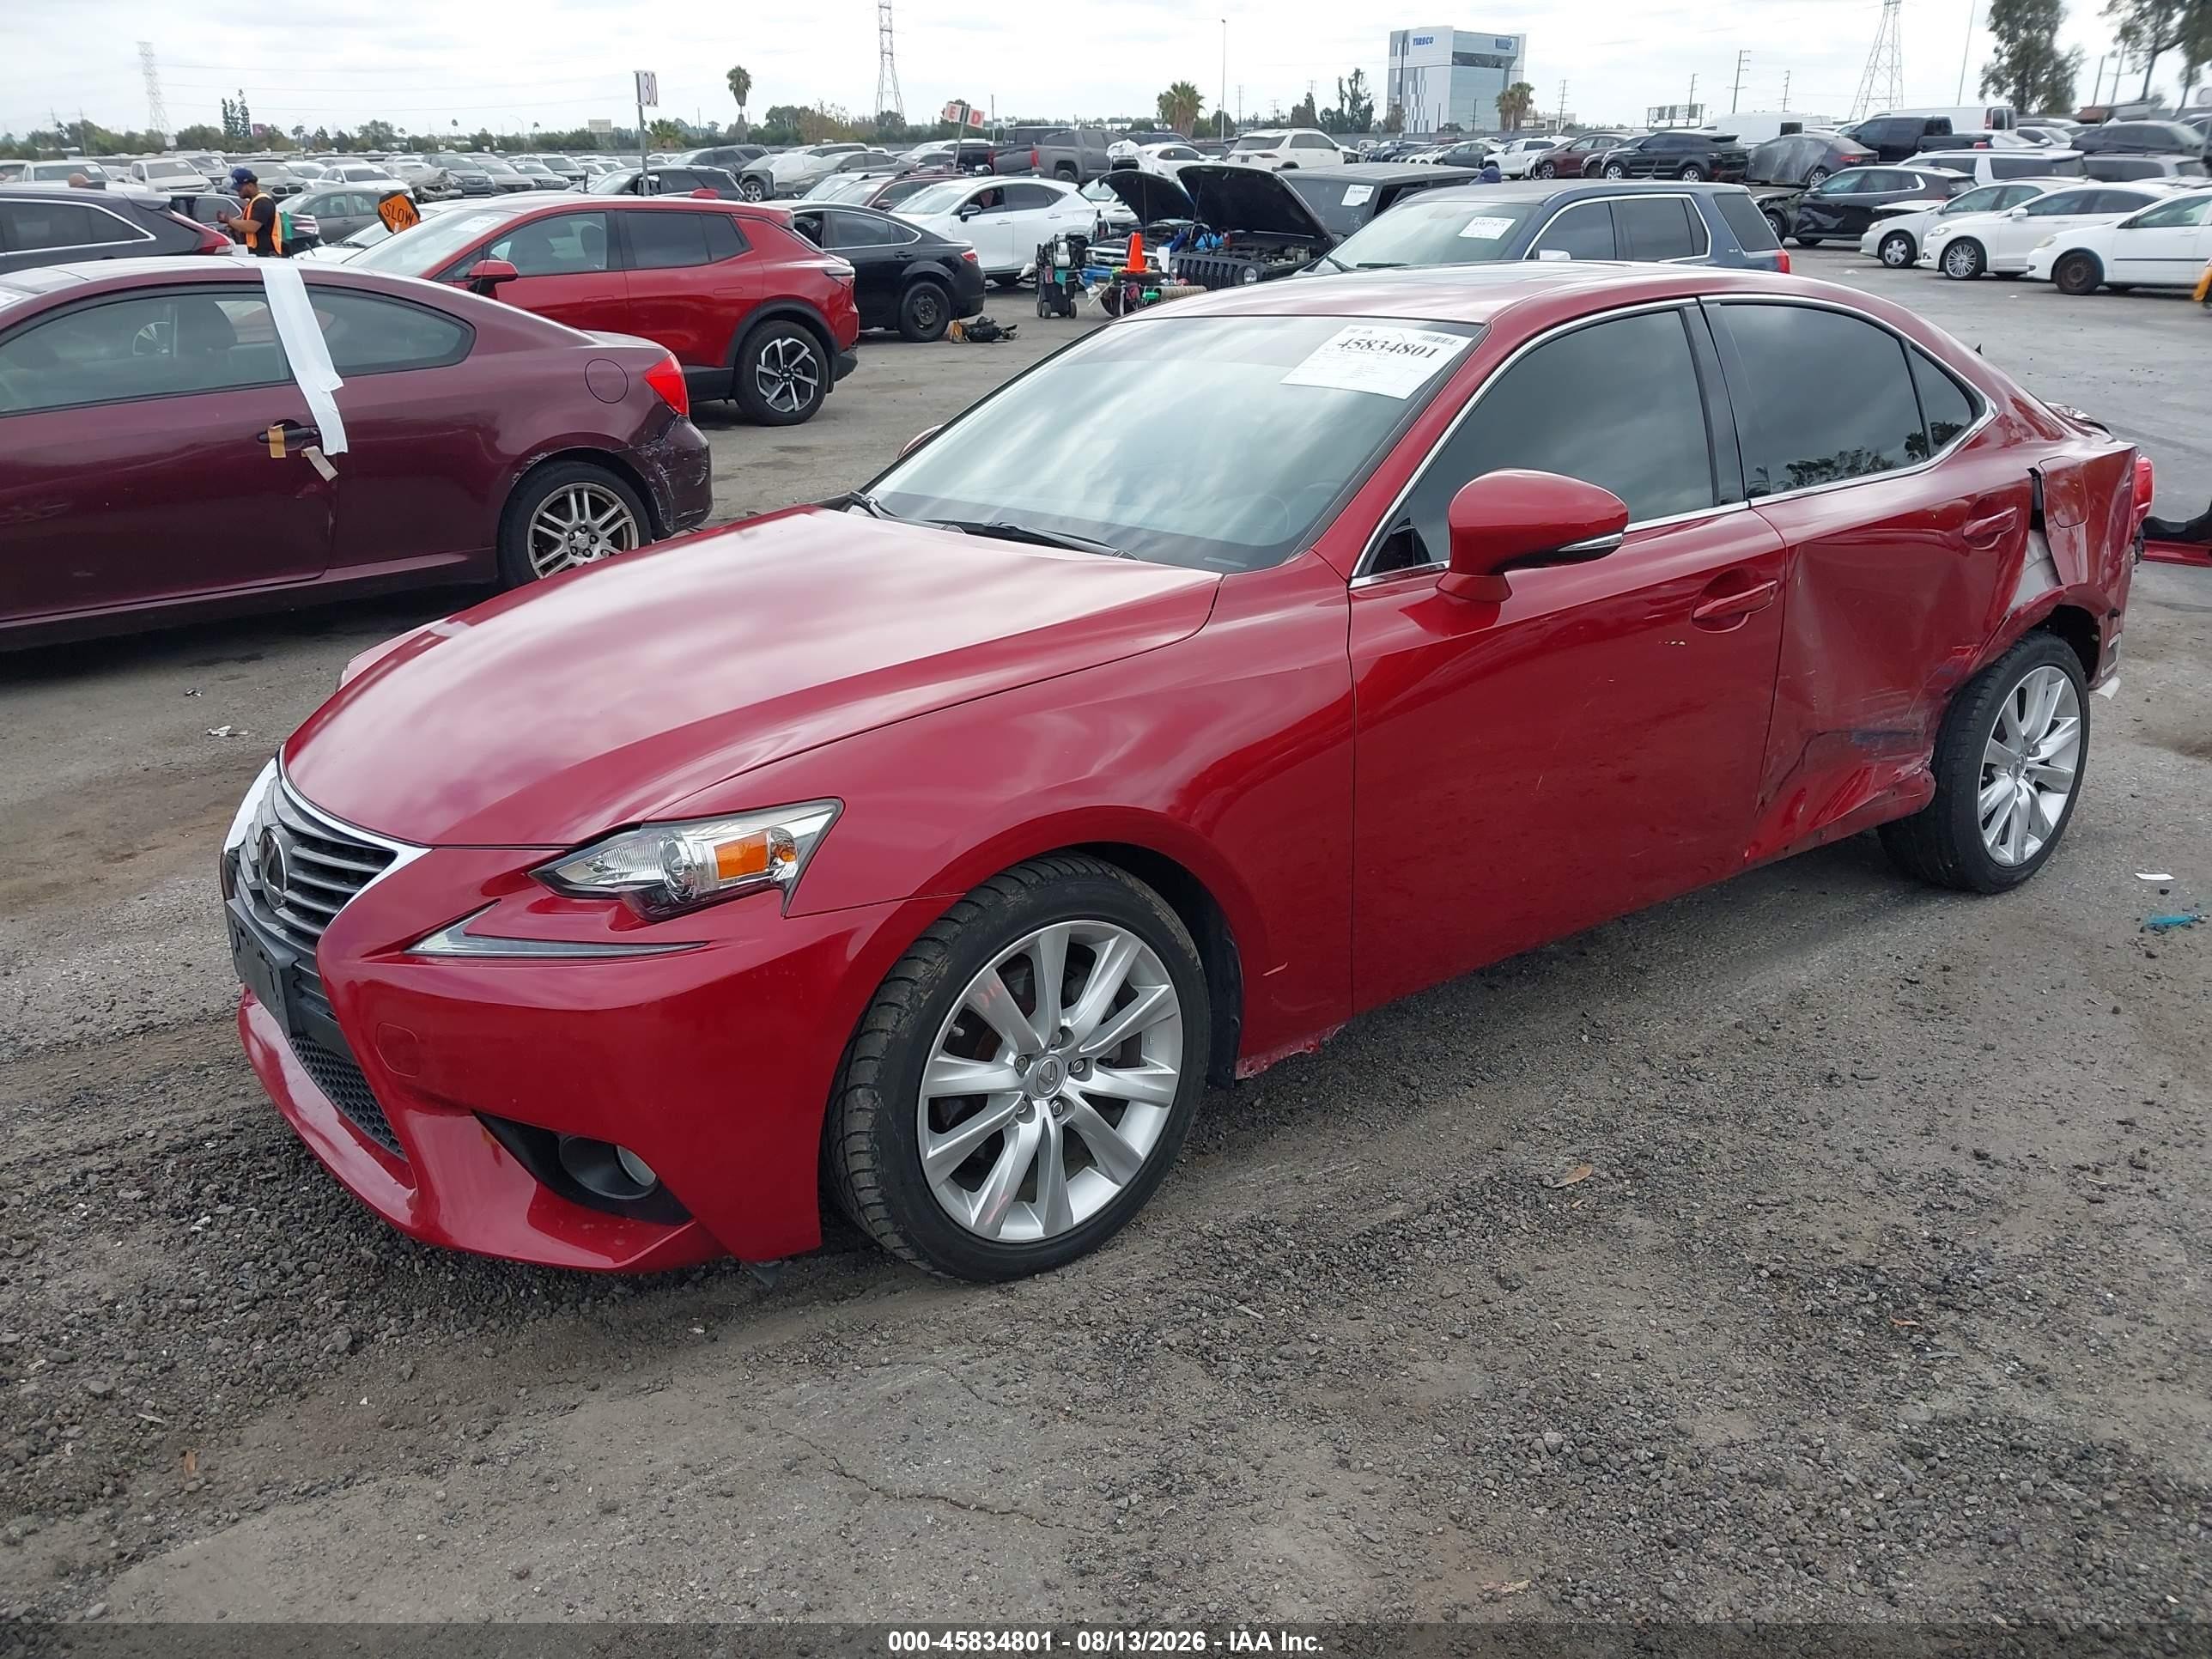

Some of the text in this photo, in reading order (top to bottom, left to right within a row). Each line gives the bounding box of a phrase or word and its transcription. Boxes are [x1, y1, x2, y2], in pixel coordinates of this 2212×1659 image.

[644, 72, 658, 105] 30
[948, 105, 957, 119] E
[971, 111, 981, 125] D
[384, 202, 415, 226] SLOW
[1337, 337, 1440, 358] 45834801
